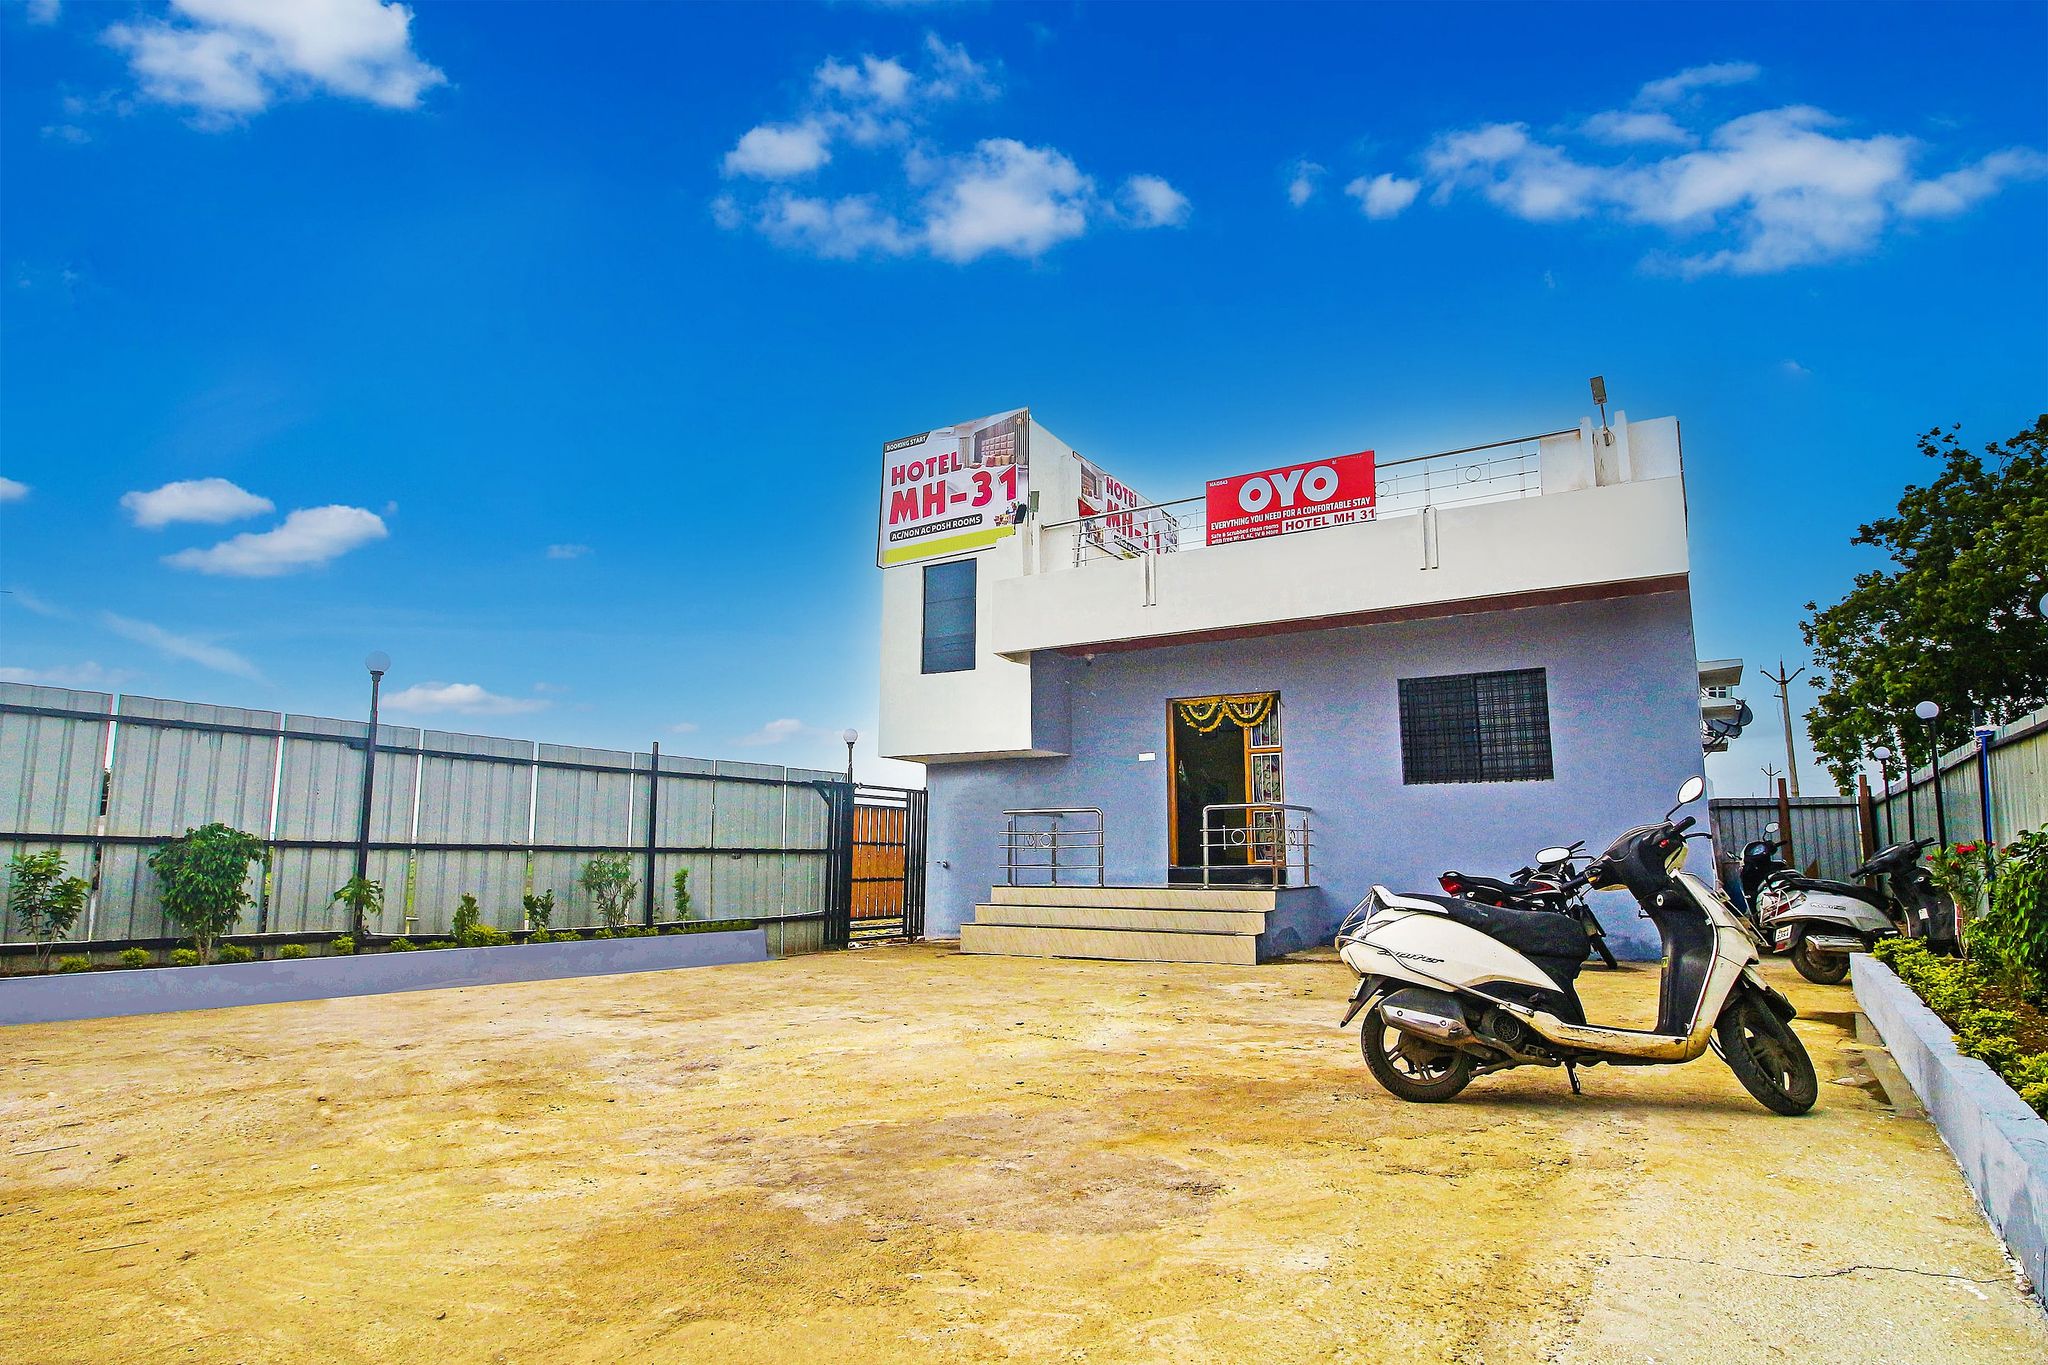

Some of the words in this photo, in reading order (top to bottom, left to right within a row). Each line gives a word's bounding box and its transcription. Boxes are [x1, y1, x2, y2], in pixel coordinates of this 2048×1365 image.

[886, 441, 910, 452] BOOKING
[910, 436, 927, 446] START
[891, 452, 963, 486] HOTEL
[889, 463, 1017, 525] MH-31
[1106, 476, 1138, 508] HOTEL
[1238, 465, 1339, 513] OYO
[891, 529, 920, 541] AC/NON
[920, 526, 931, 535] AC
[931, 521, 952, 533] POSH
[952, 516, 981, 528] ROOMS
[1211, 516, 1250, 531] EVERYTHING
[1250, 513, 1264, 524] YOU
[1264, 511, 1282, 521] NEED
[1282, 508, 1296, 518] FOR
[1296, 507, 1302, 516] A
[1302, 500, 1352, 515] COMFORTABLE
[1352, 496, 1371, 507] STAY
[1285, 516, 1330, 531] HOTEL
[1334, 512, 1355, 524] MH
[1360, 508, 1375, 520] 31
